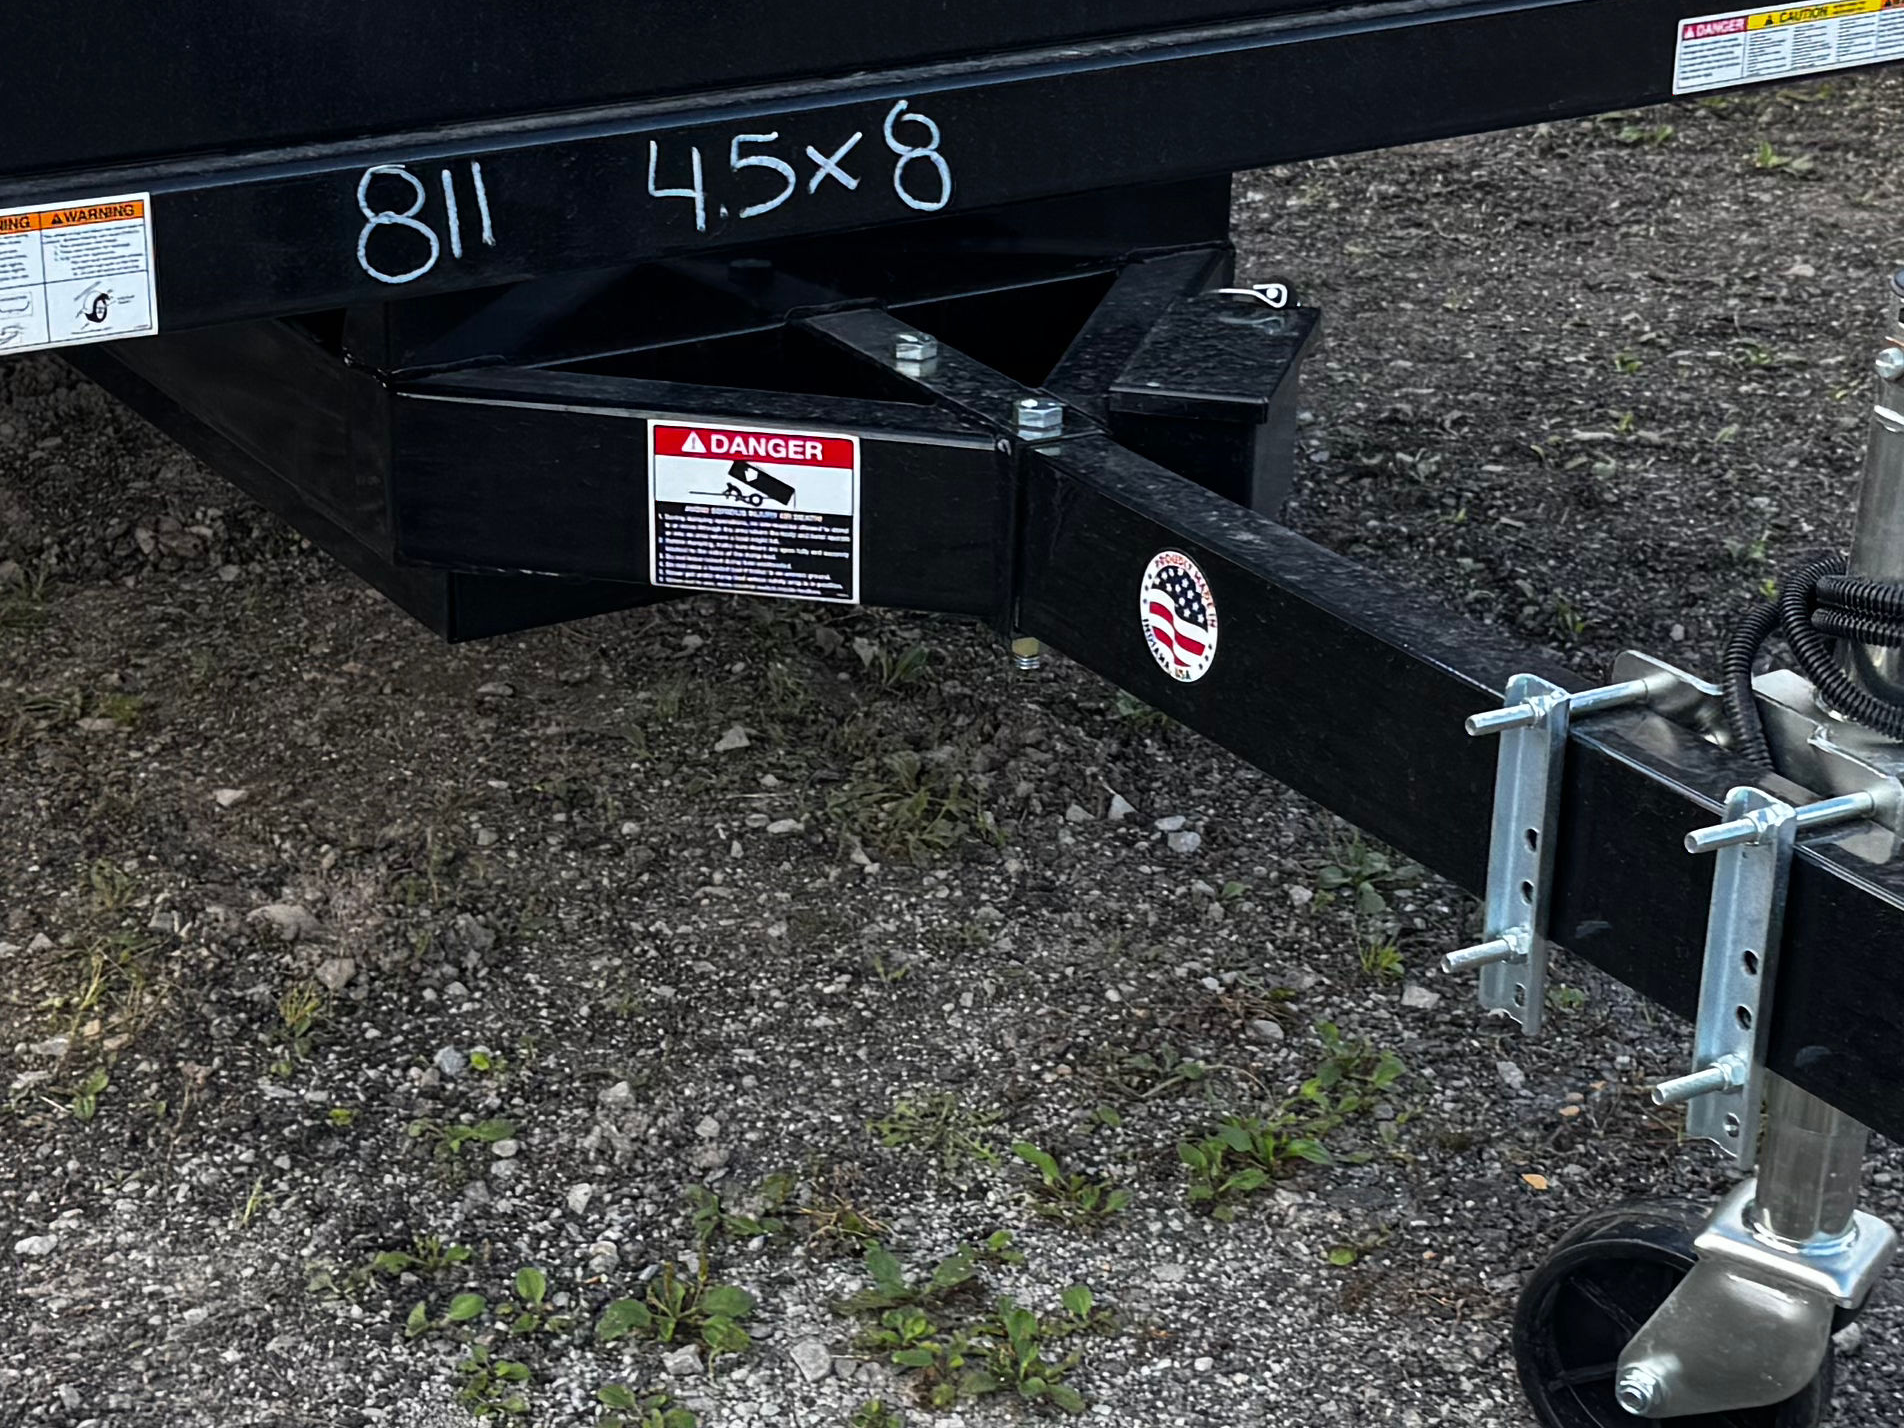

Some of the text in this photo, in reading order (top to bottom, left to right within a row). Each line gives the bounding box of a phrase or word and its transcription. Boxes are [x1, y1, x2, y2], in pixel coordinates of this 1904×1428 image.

[1695, 17, 1746, 38] DANGER
[1778, 6, 1829, 24] CAUTION
[64, 203, 135, 224] WARNING
[356, 162, 496, 284] 811
[709, 433, 824, 461] DANGER
